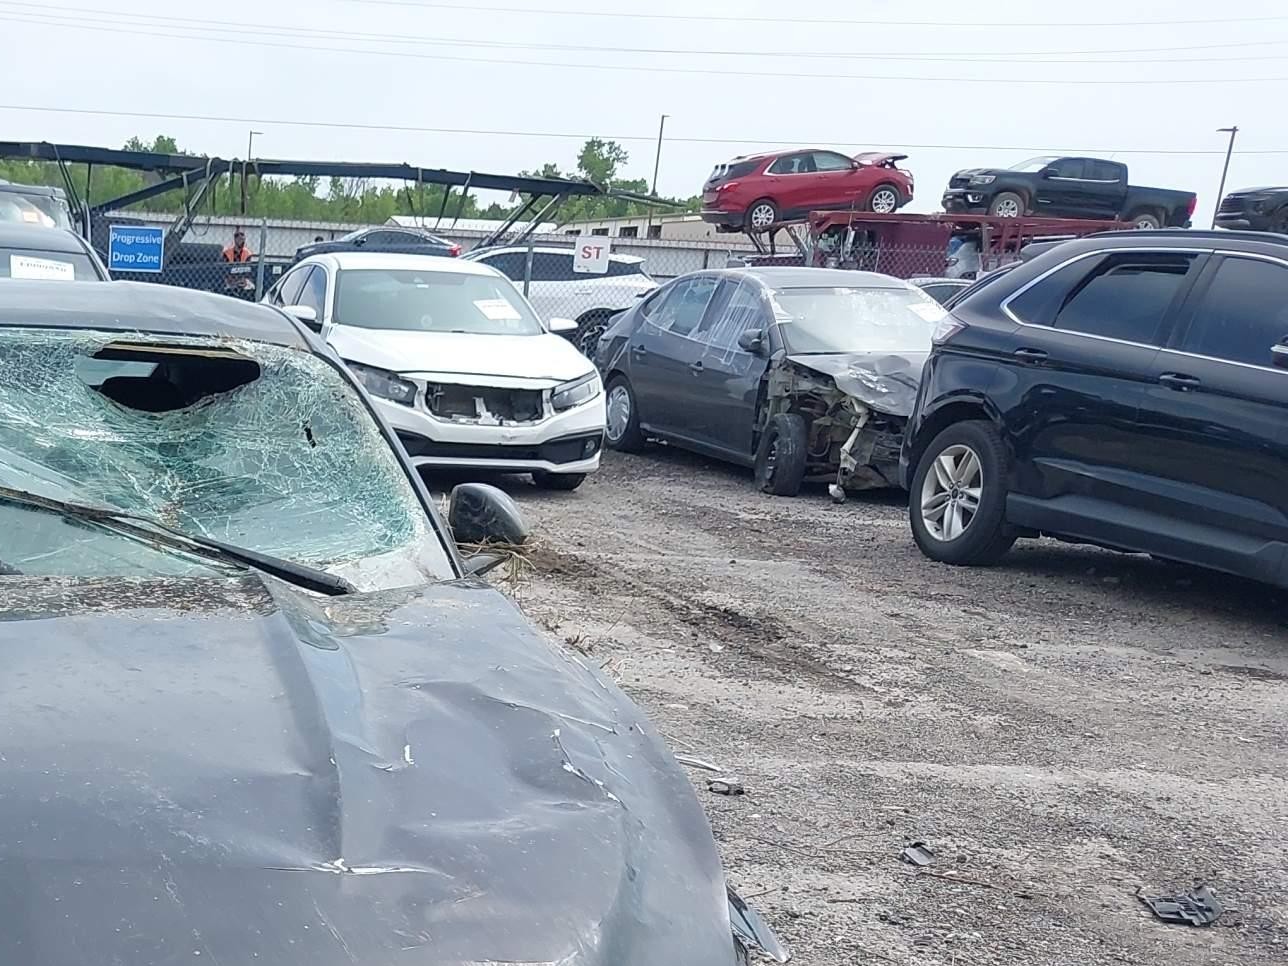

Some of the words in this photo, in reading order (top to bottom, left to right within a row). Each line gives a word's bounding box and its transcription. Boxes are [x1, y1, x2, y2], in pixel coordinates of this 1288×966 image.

[111, 233, 162, 245] Progressive
[112, 252, 136, 264] Drop
[137, 253, 159, 263] Zone
[581, 246, 604, 259] ST
